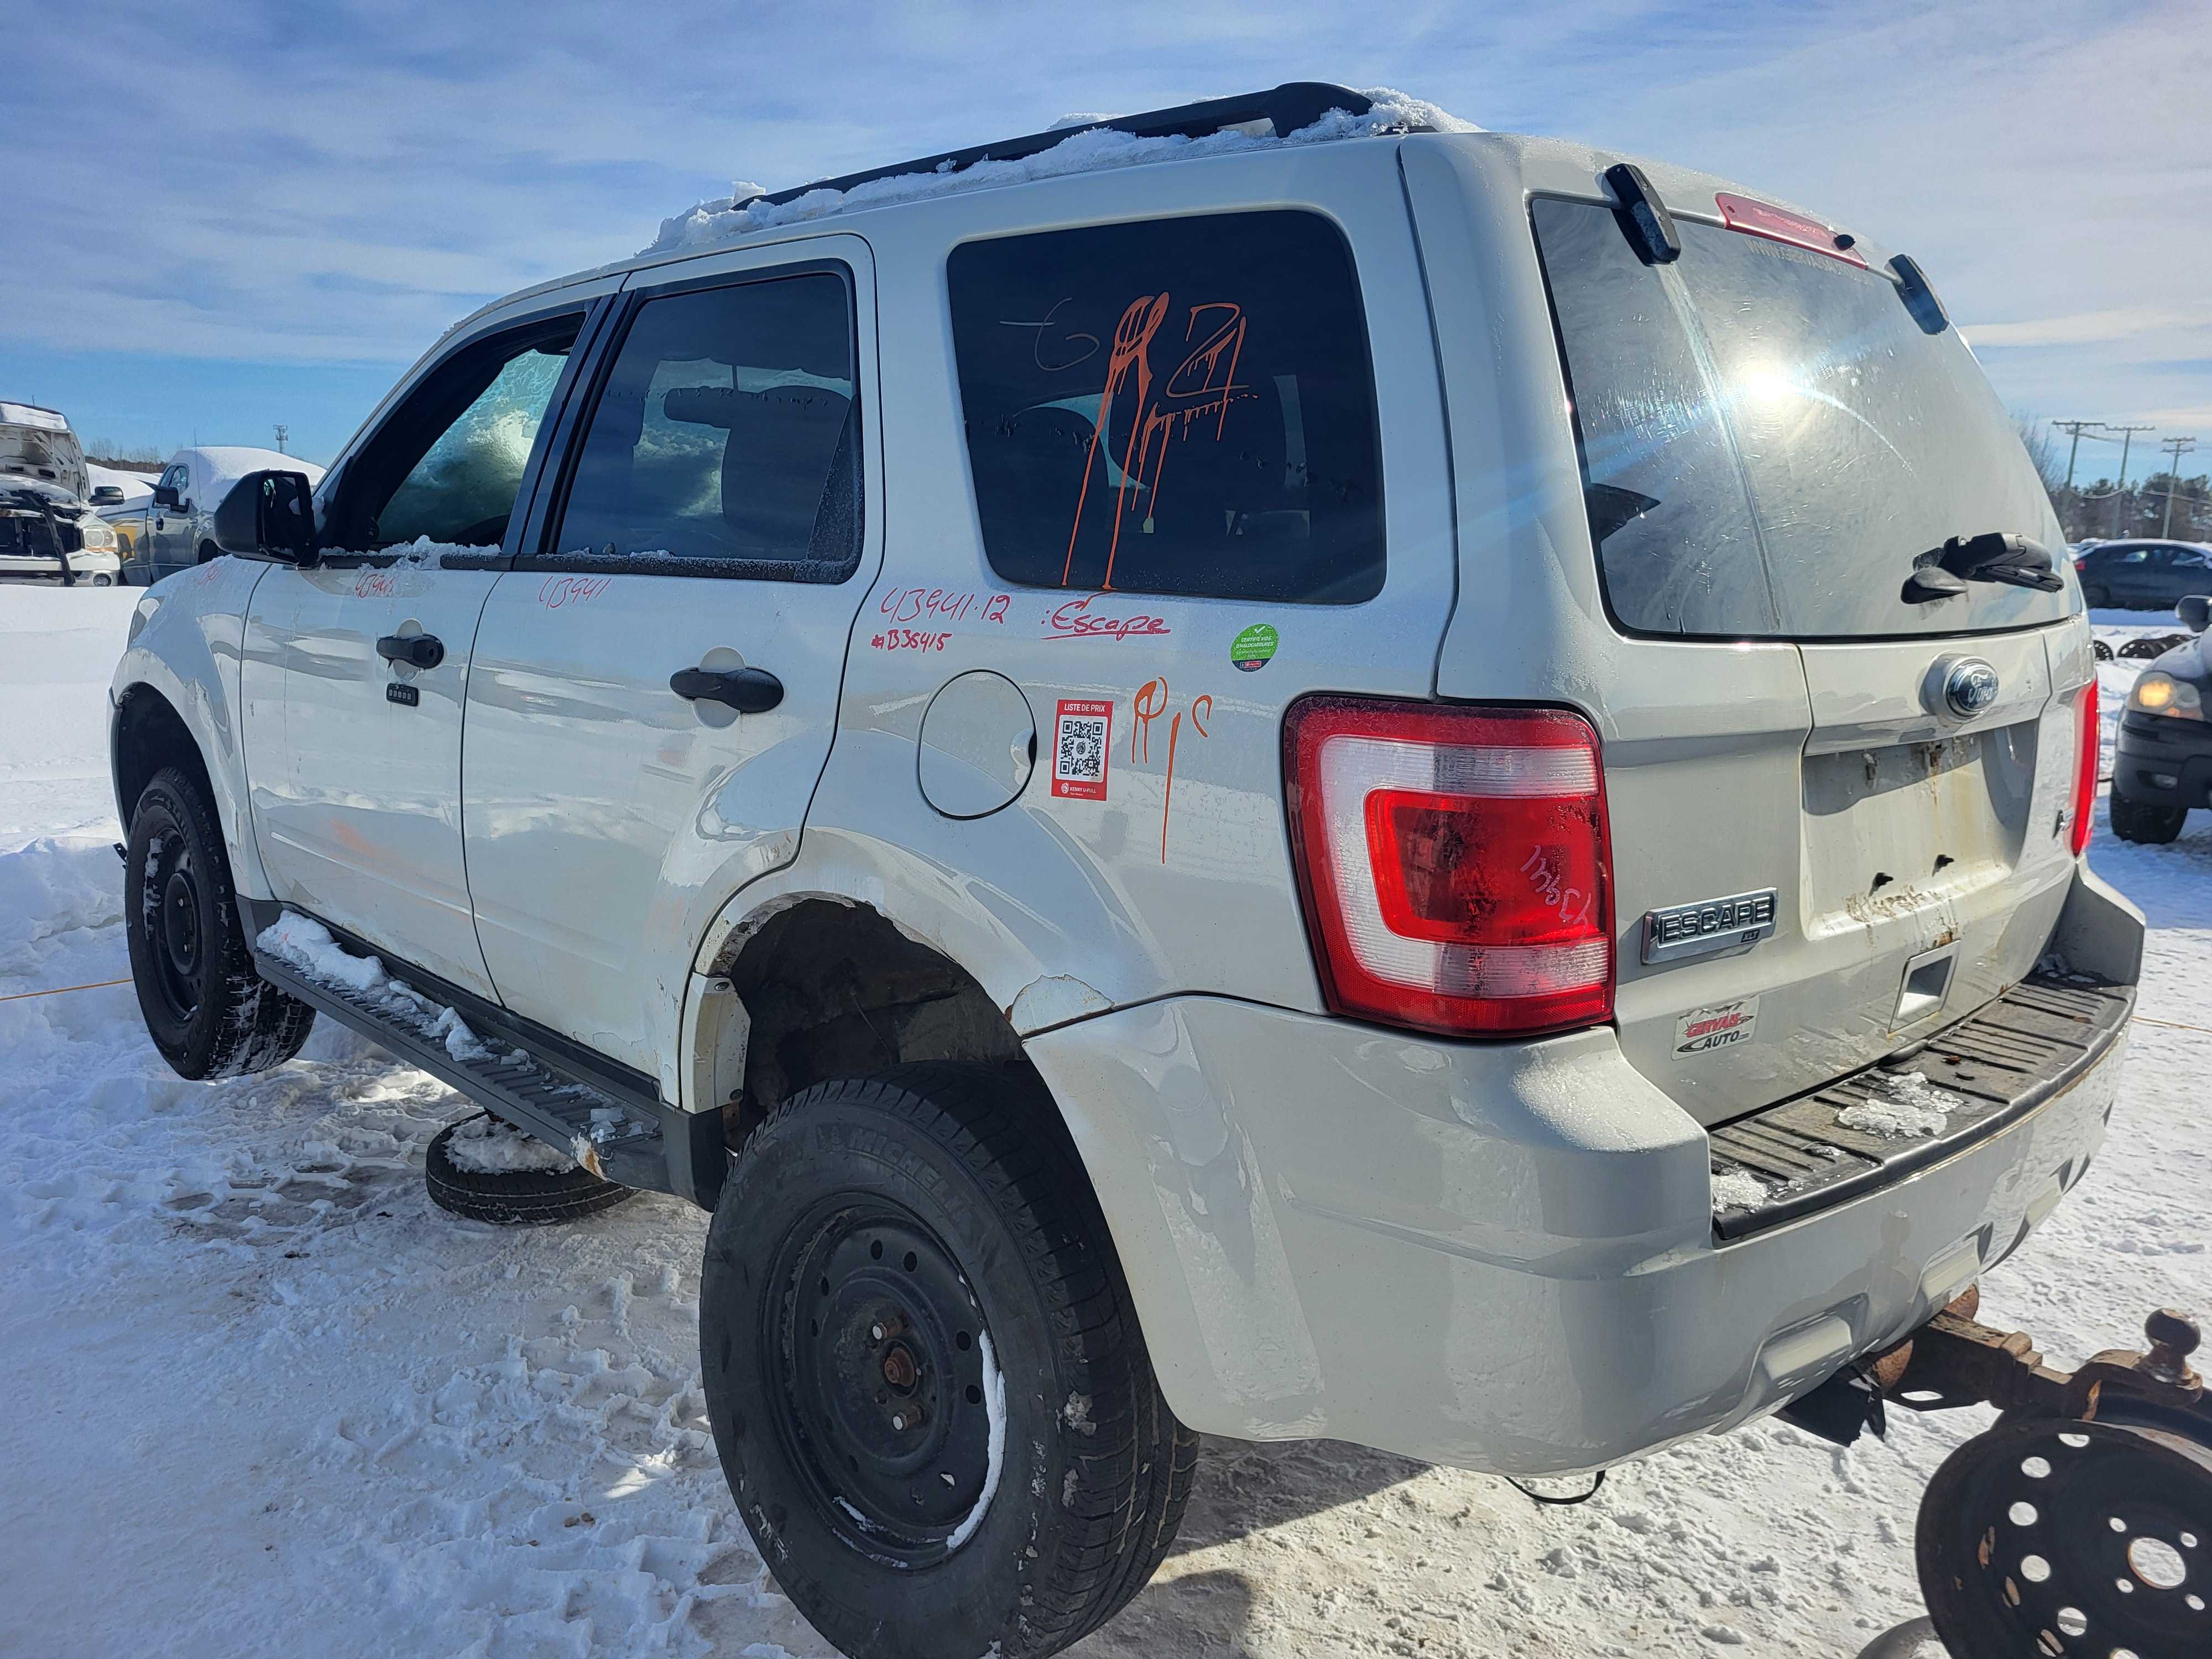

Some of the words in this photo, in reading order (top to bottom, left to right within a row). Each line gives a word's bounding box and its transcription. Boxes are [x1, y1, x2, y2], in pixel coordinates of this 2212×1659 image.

[1064, 703, 1081, 711] LISTE
[1660, 896, 1771, 943] ESCAPE
[1703, 1030, 1740, 1050] AUTO
